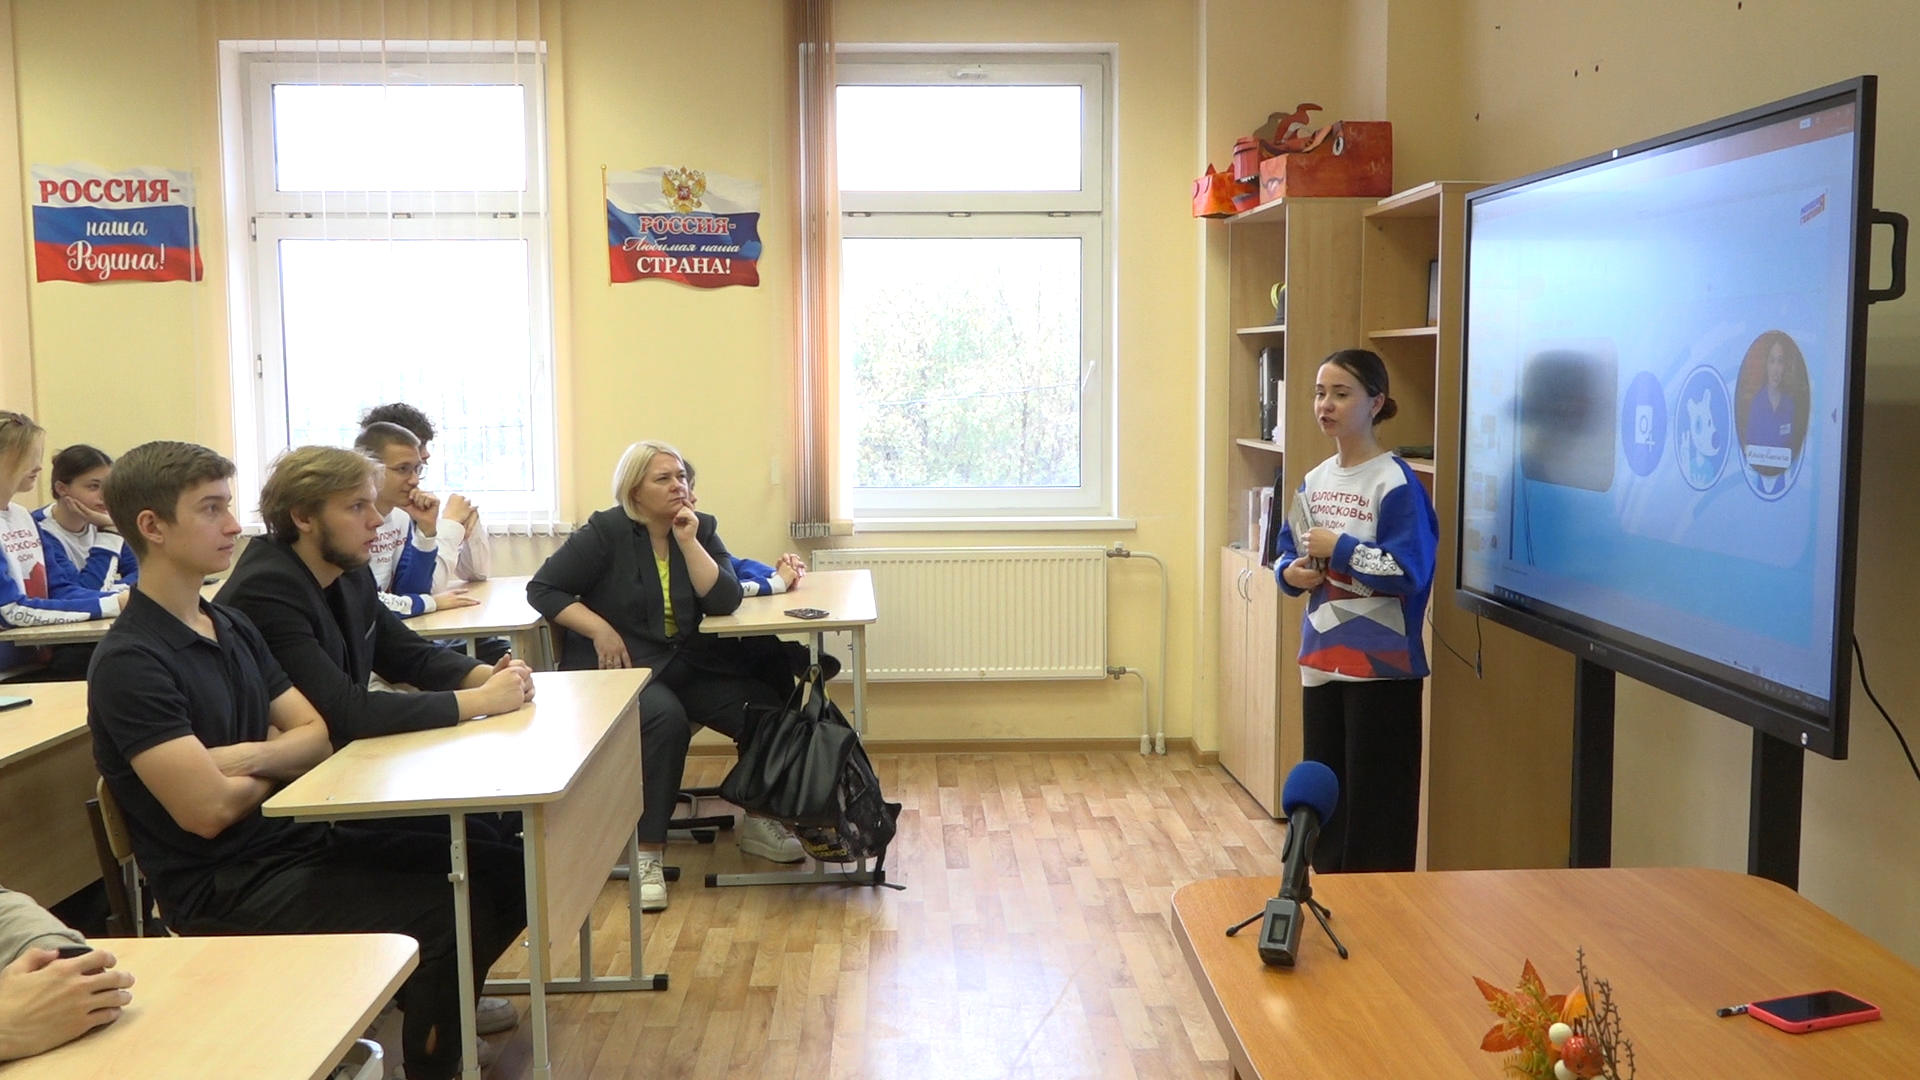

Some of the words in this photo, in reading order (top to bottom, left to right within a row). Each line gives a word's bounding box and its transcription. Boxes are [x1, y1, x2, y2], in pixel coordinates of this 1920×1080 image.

[38, 179, 180, 203] РОССИЯ-
[86, 220, 149, 237] наша
[639, 215, 737, 235] РОССИЯ-
[622, 235, 697, 253] Любимая
[700, 243, 741, 253] наша
[66, 239, 165, 280] Родина!
[636, 256, 731, 275] СТРАНА!
[1310, 504, 1373, 522] ДМОСКОВЬЯ
